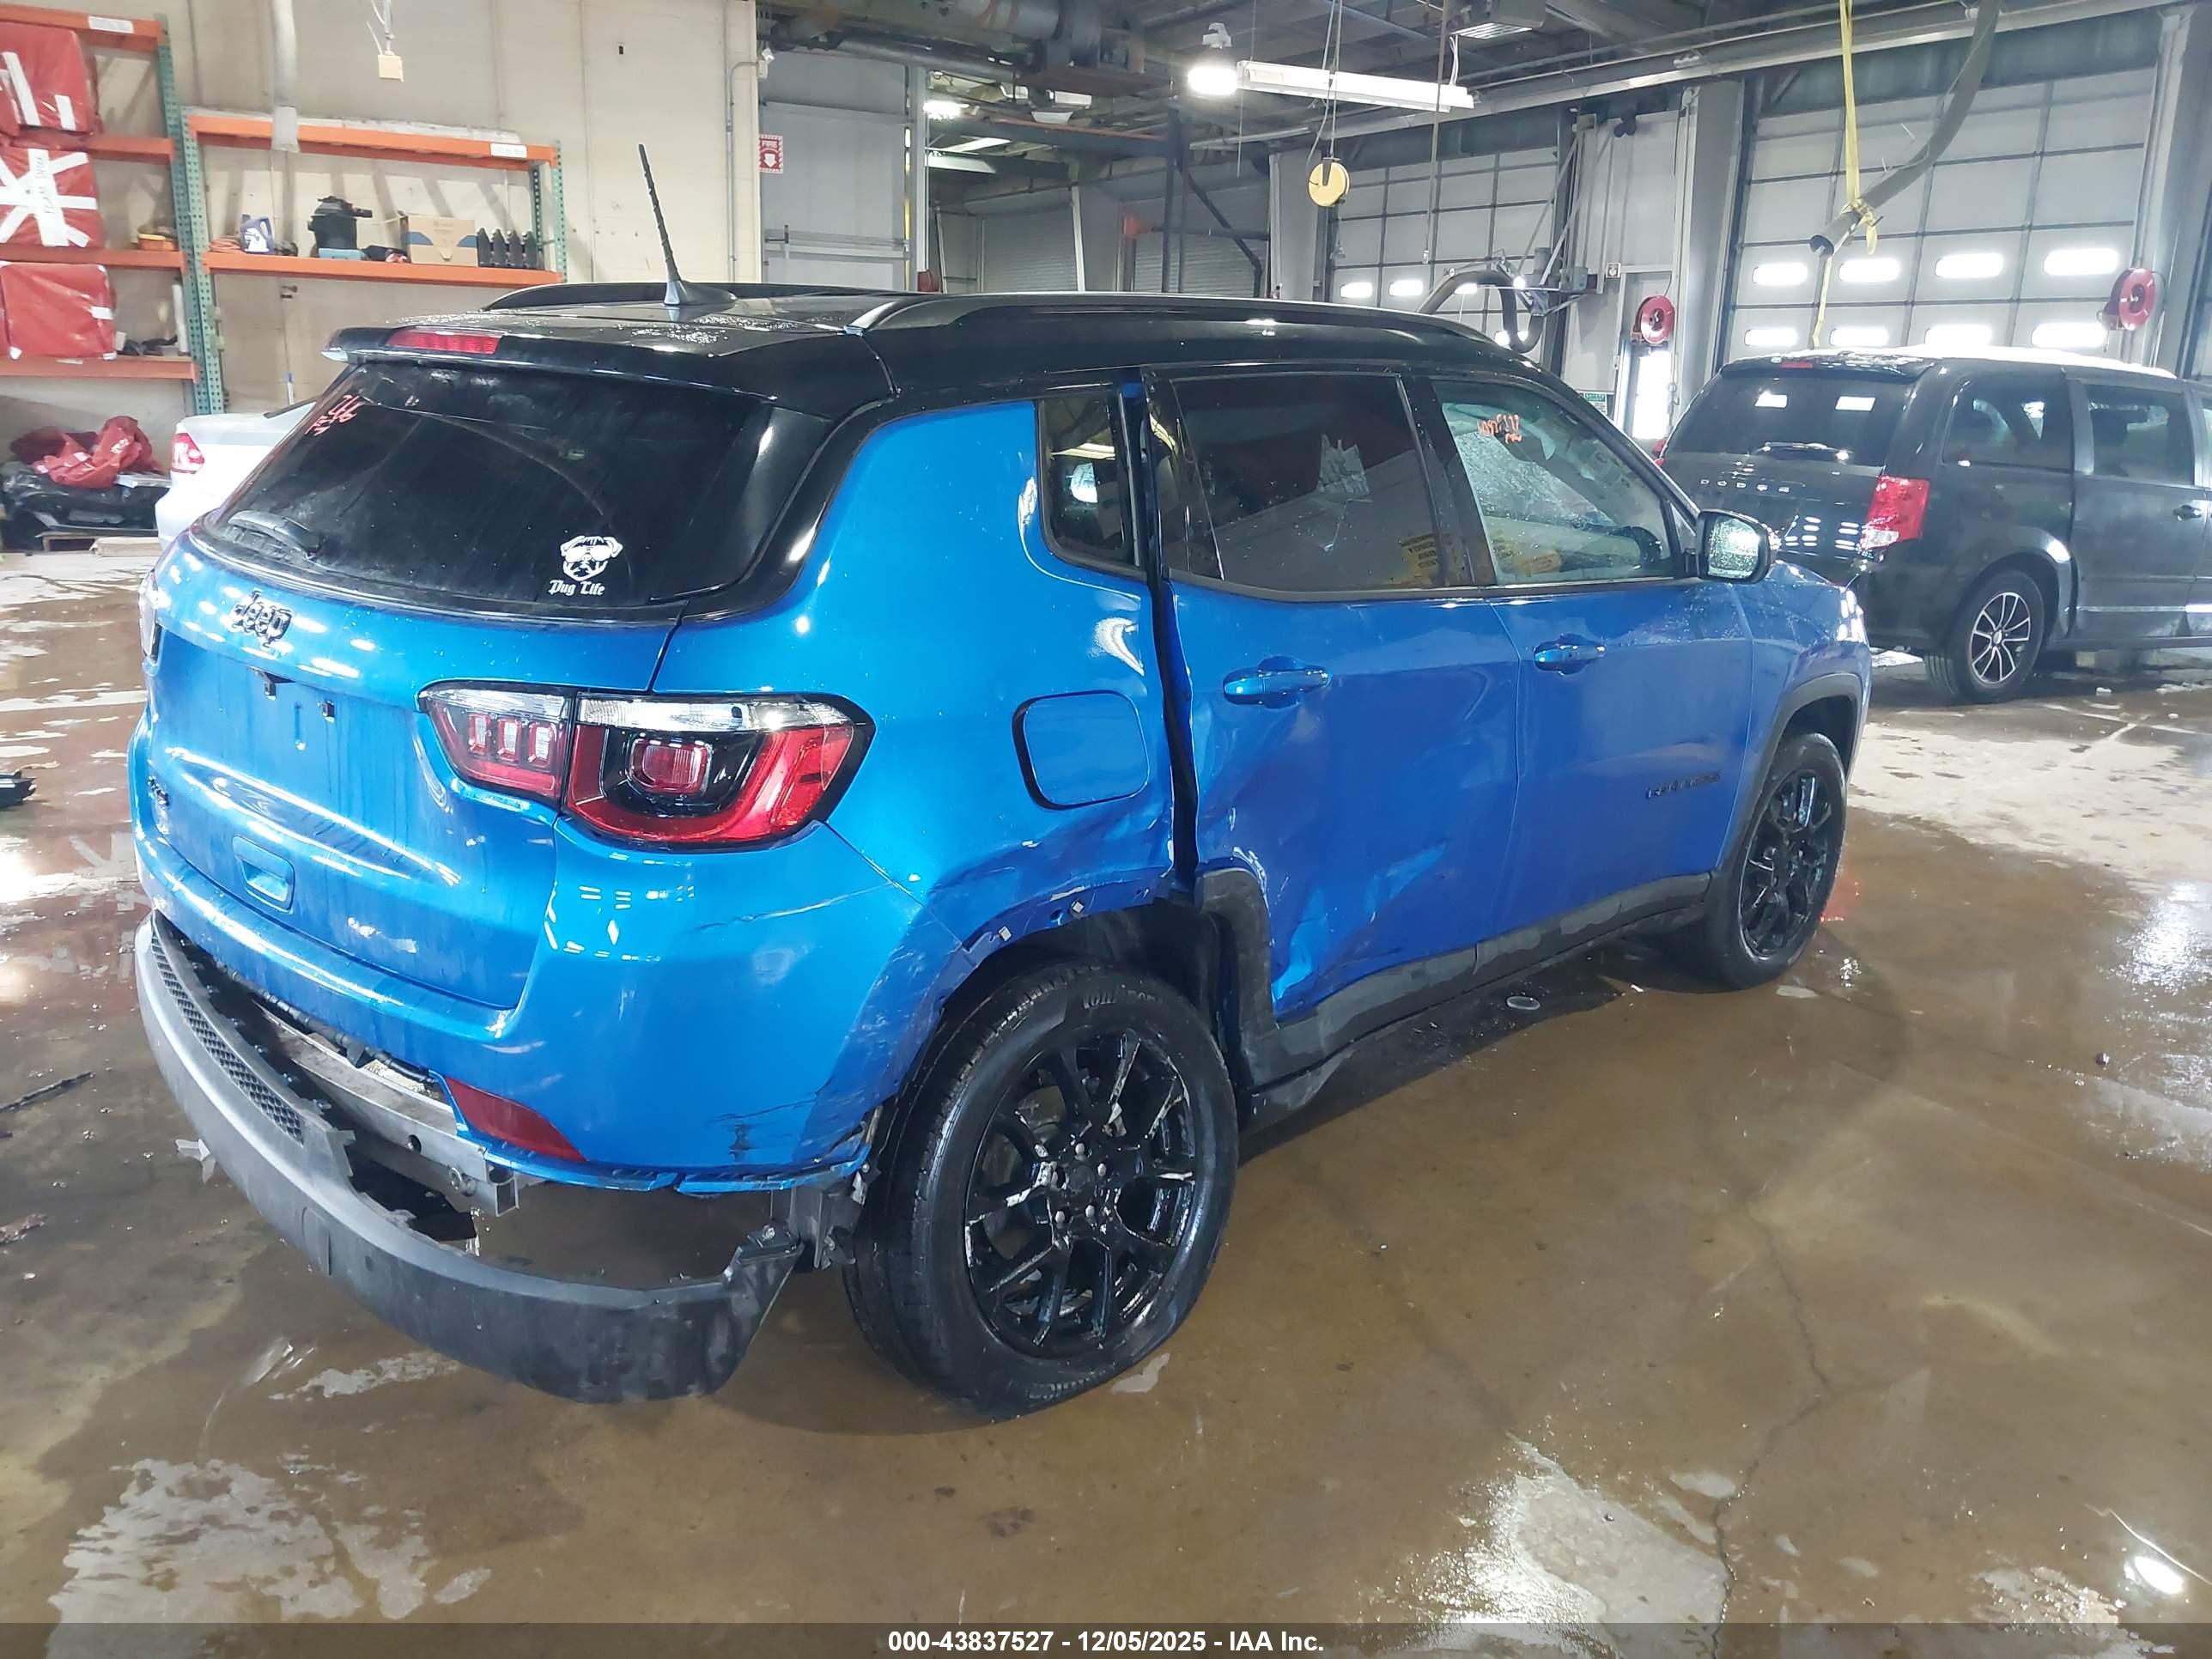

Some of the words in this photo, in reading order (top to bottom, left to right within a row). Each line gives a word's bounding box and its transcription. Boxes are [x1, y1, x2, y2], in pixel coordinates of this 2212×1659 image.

[762, 139, 779, 149] FIRE
[1700, 479, 1790, 494] DODGE
[548, 579, 576, 596] Pug
[580, 580, 605, 596] Life
[231, 589, 293, 649] Jeep
